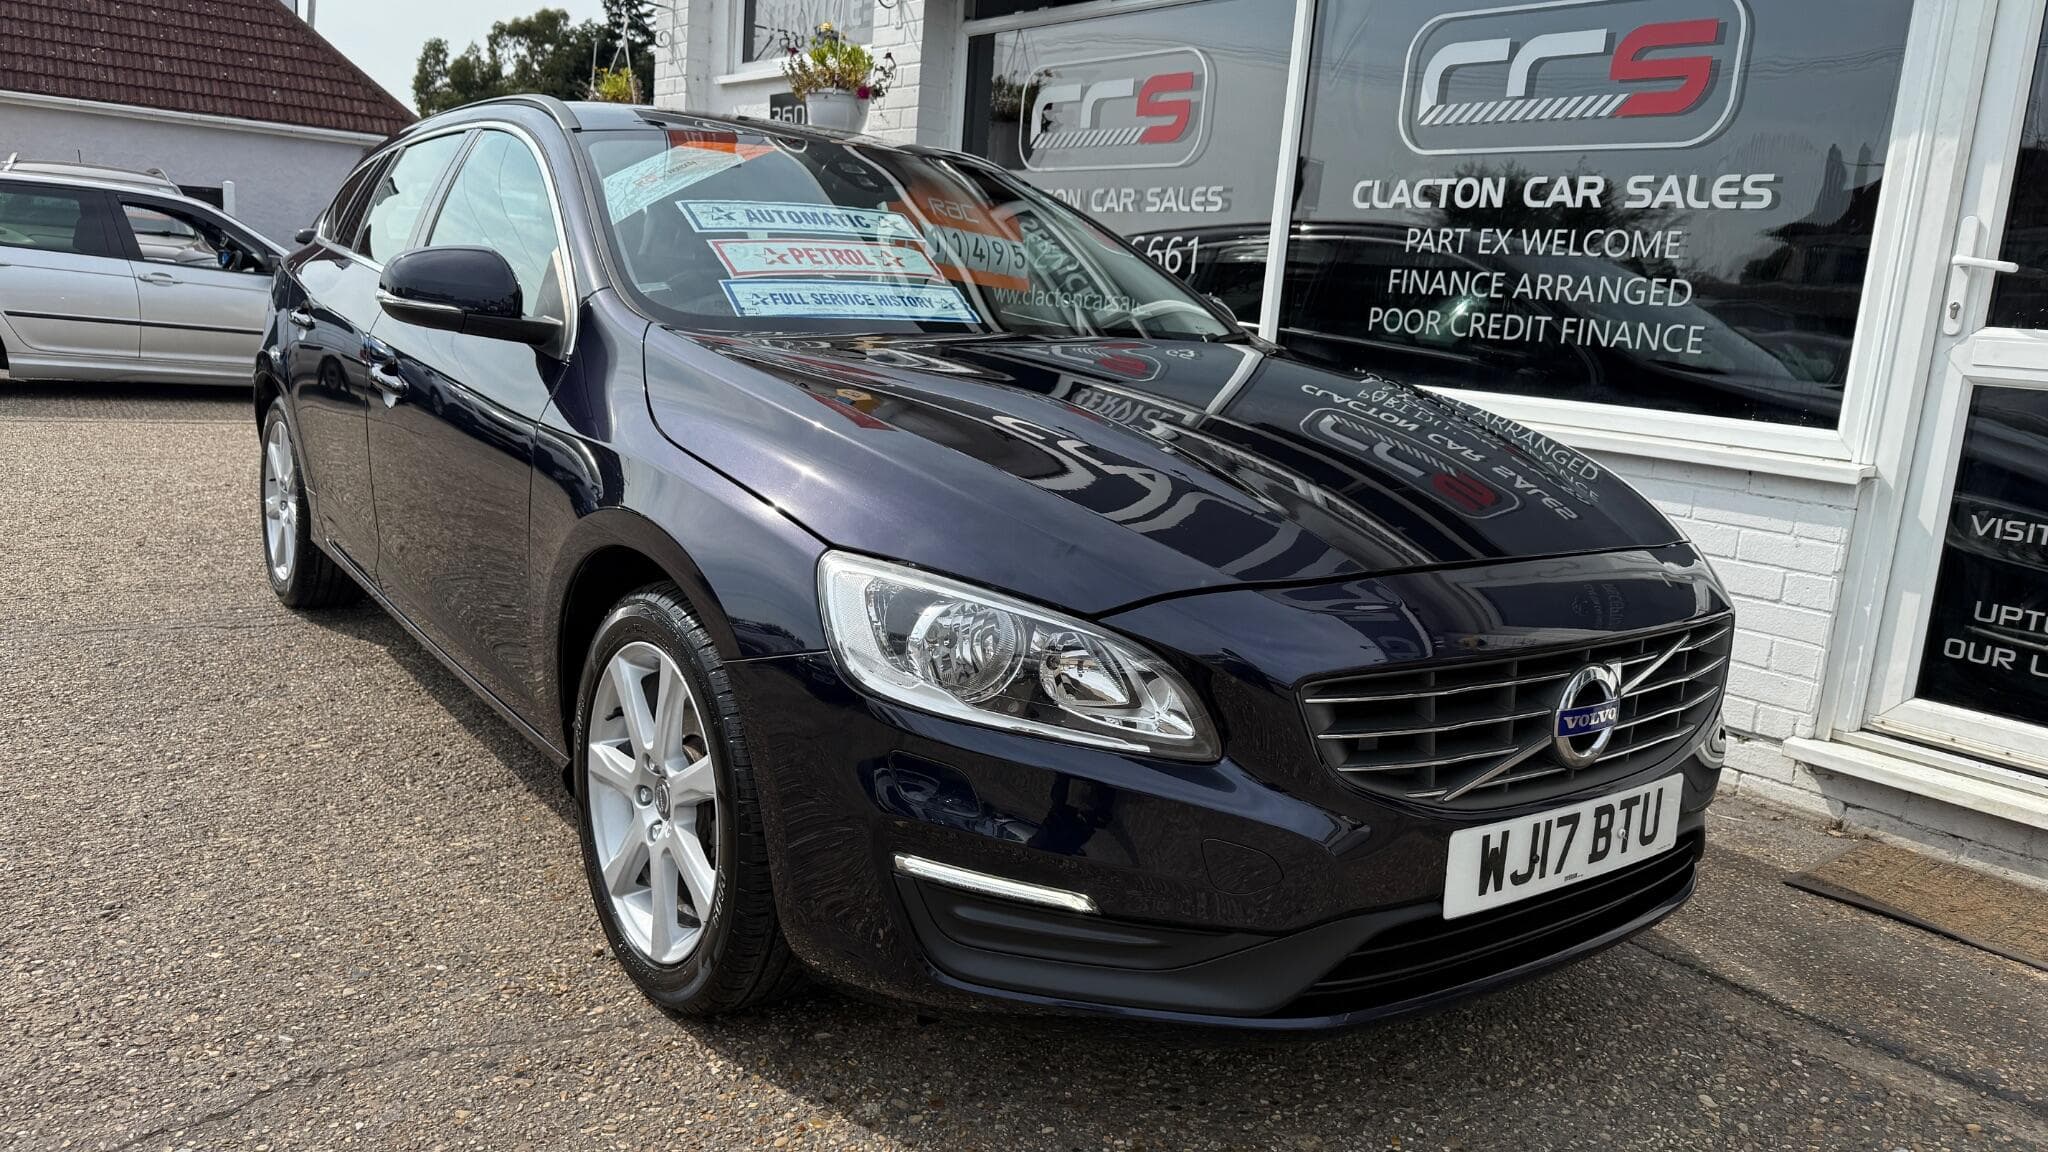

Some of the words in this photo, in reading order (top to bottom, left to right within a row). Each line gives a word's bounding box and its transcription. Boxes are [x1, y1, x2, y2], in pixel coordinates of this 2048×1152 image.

[1091, 187, 1136, 212] CAR
[1145, 186, 1224, 212] SALES
[1352, 177, 1506, 209] CLACTON
[1523, 176, 1605, 209] CAR
[1624, 173, 1776, 209] SALES
[744, 208, 871, 229] AUTOMATIC
[791, 247, 876, 267] PETROL
[1404, 228, 1472, 254] PART
[1478, 229, 1515, 256] EX
[1522, 229, 1683, 259] WELCOME
[769, 292, 805, 306] FULL
[811, 293, 875, 307] SERVICE
[878, 294, 934, 309] HISTORY
[1388, 269, 1506, 299] FINANCE
[1512, 272, 1693, 307] ARRANGED
[1368, 308, 1441, 336] POOR
[1449, 311, 1553, 344] CREDIT
[1560, 317, 1705, 354] FINANCE
[1974, 600, 2048, 633] UPT
[1943, 638, 2017, 670] OUR
[1563, 706, 1617, 729] VOLVO
[1478, 813, 1581, 896] WJ17
[1588, 788, 1663, 864] BTU
